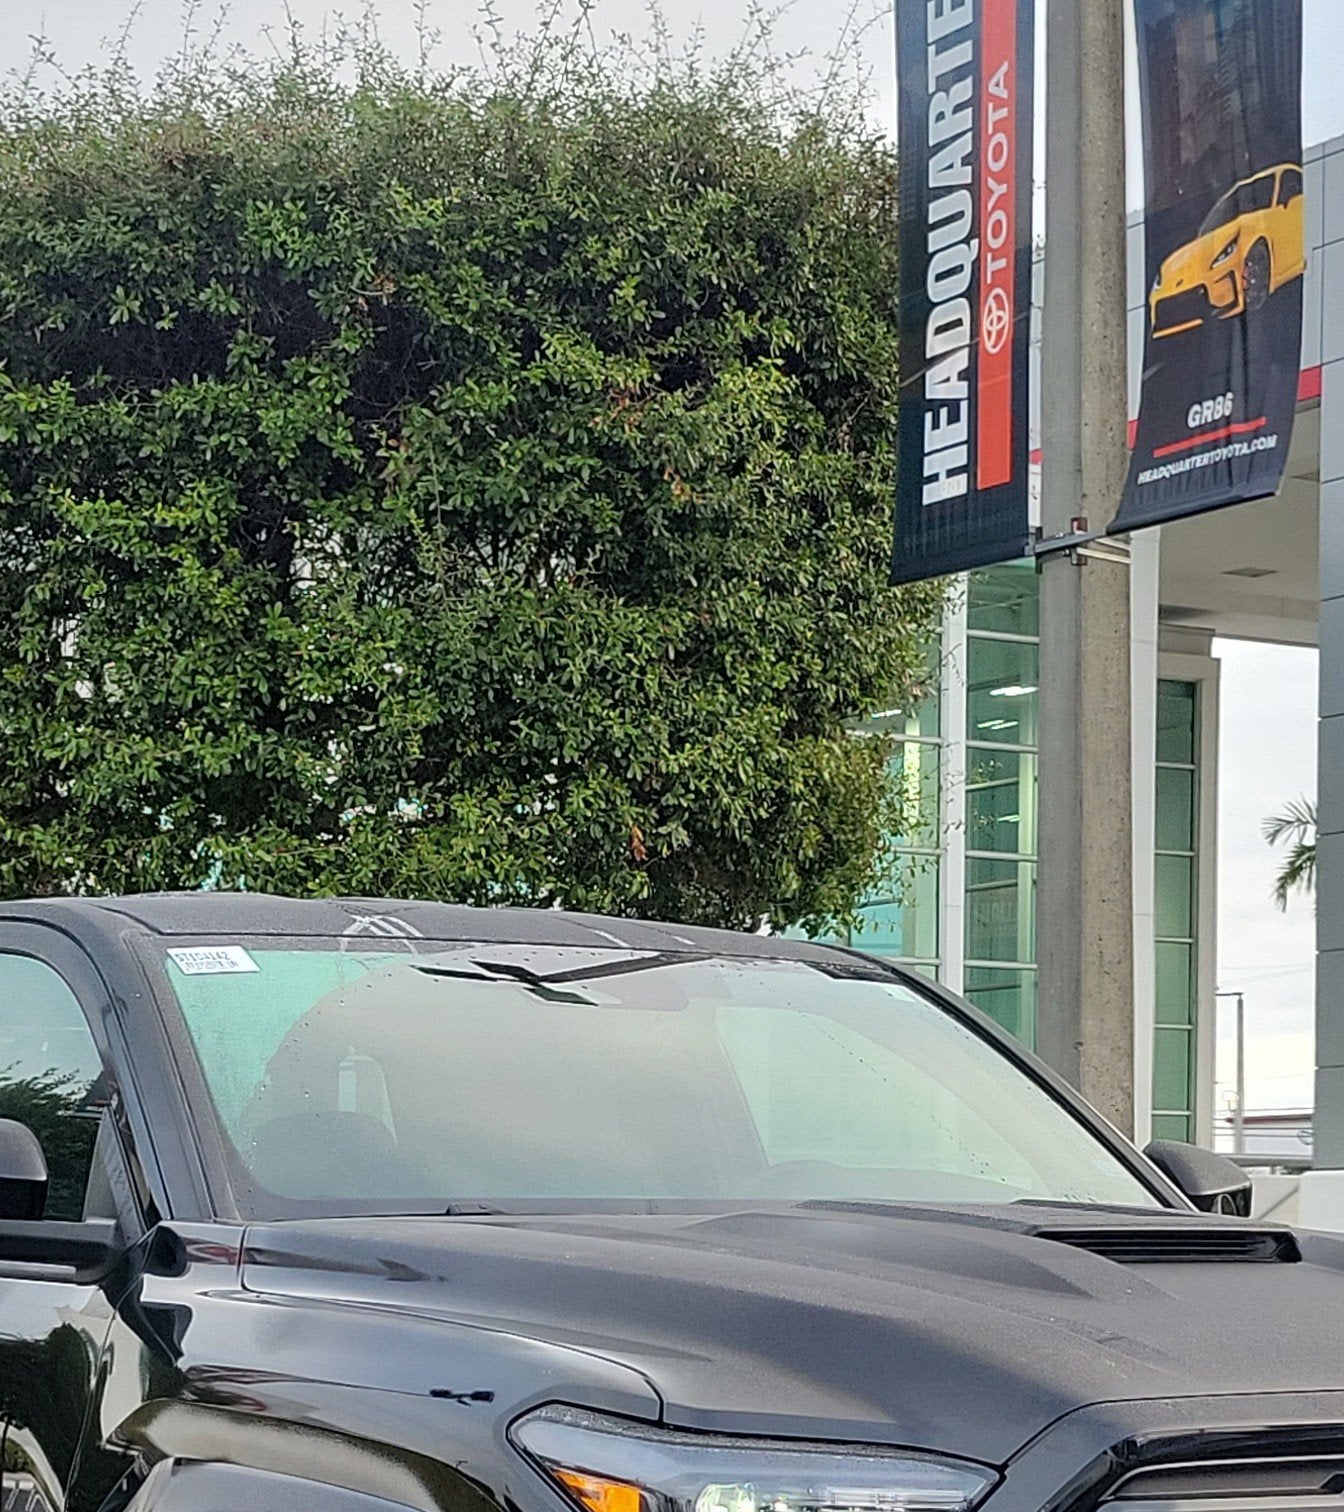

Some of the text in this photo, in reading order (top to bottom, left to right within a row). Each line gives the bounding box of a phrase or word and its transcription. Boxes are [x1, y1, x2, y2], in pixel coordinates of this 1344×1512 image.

[985, 60, 1010, 285] TOYOTA
[1187, 391, 1234, 429] GR86
[1137, 434, 1278, 485] HEADQUARTERTOYOTA.COM
